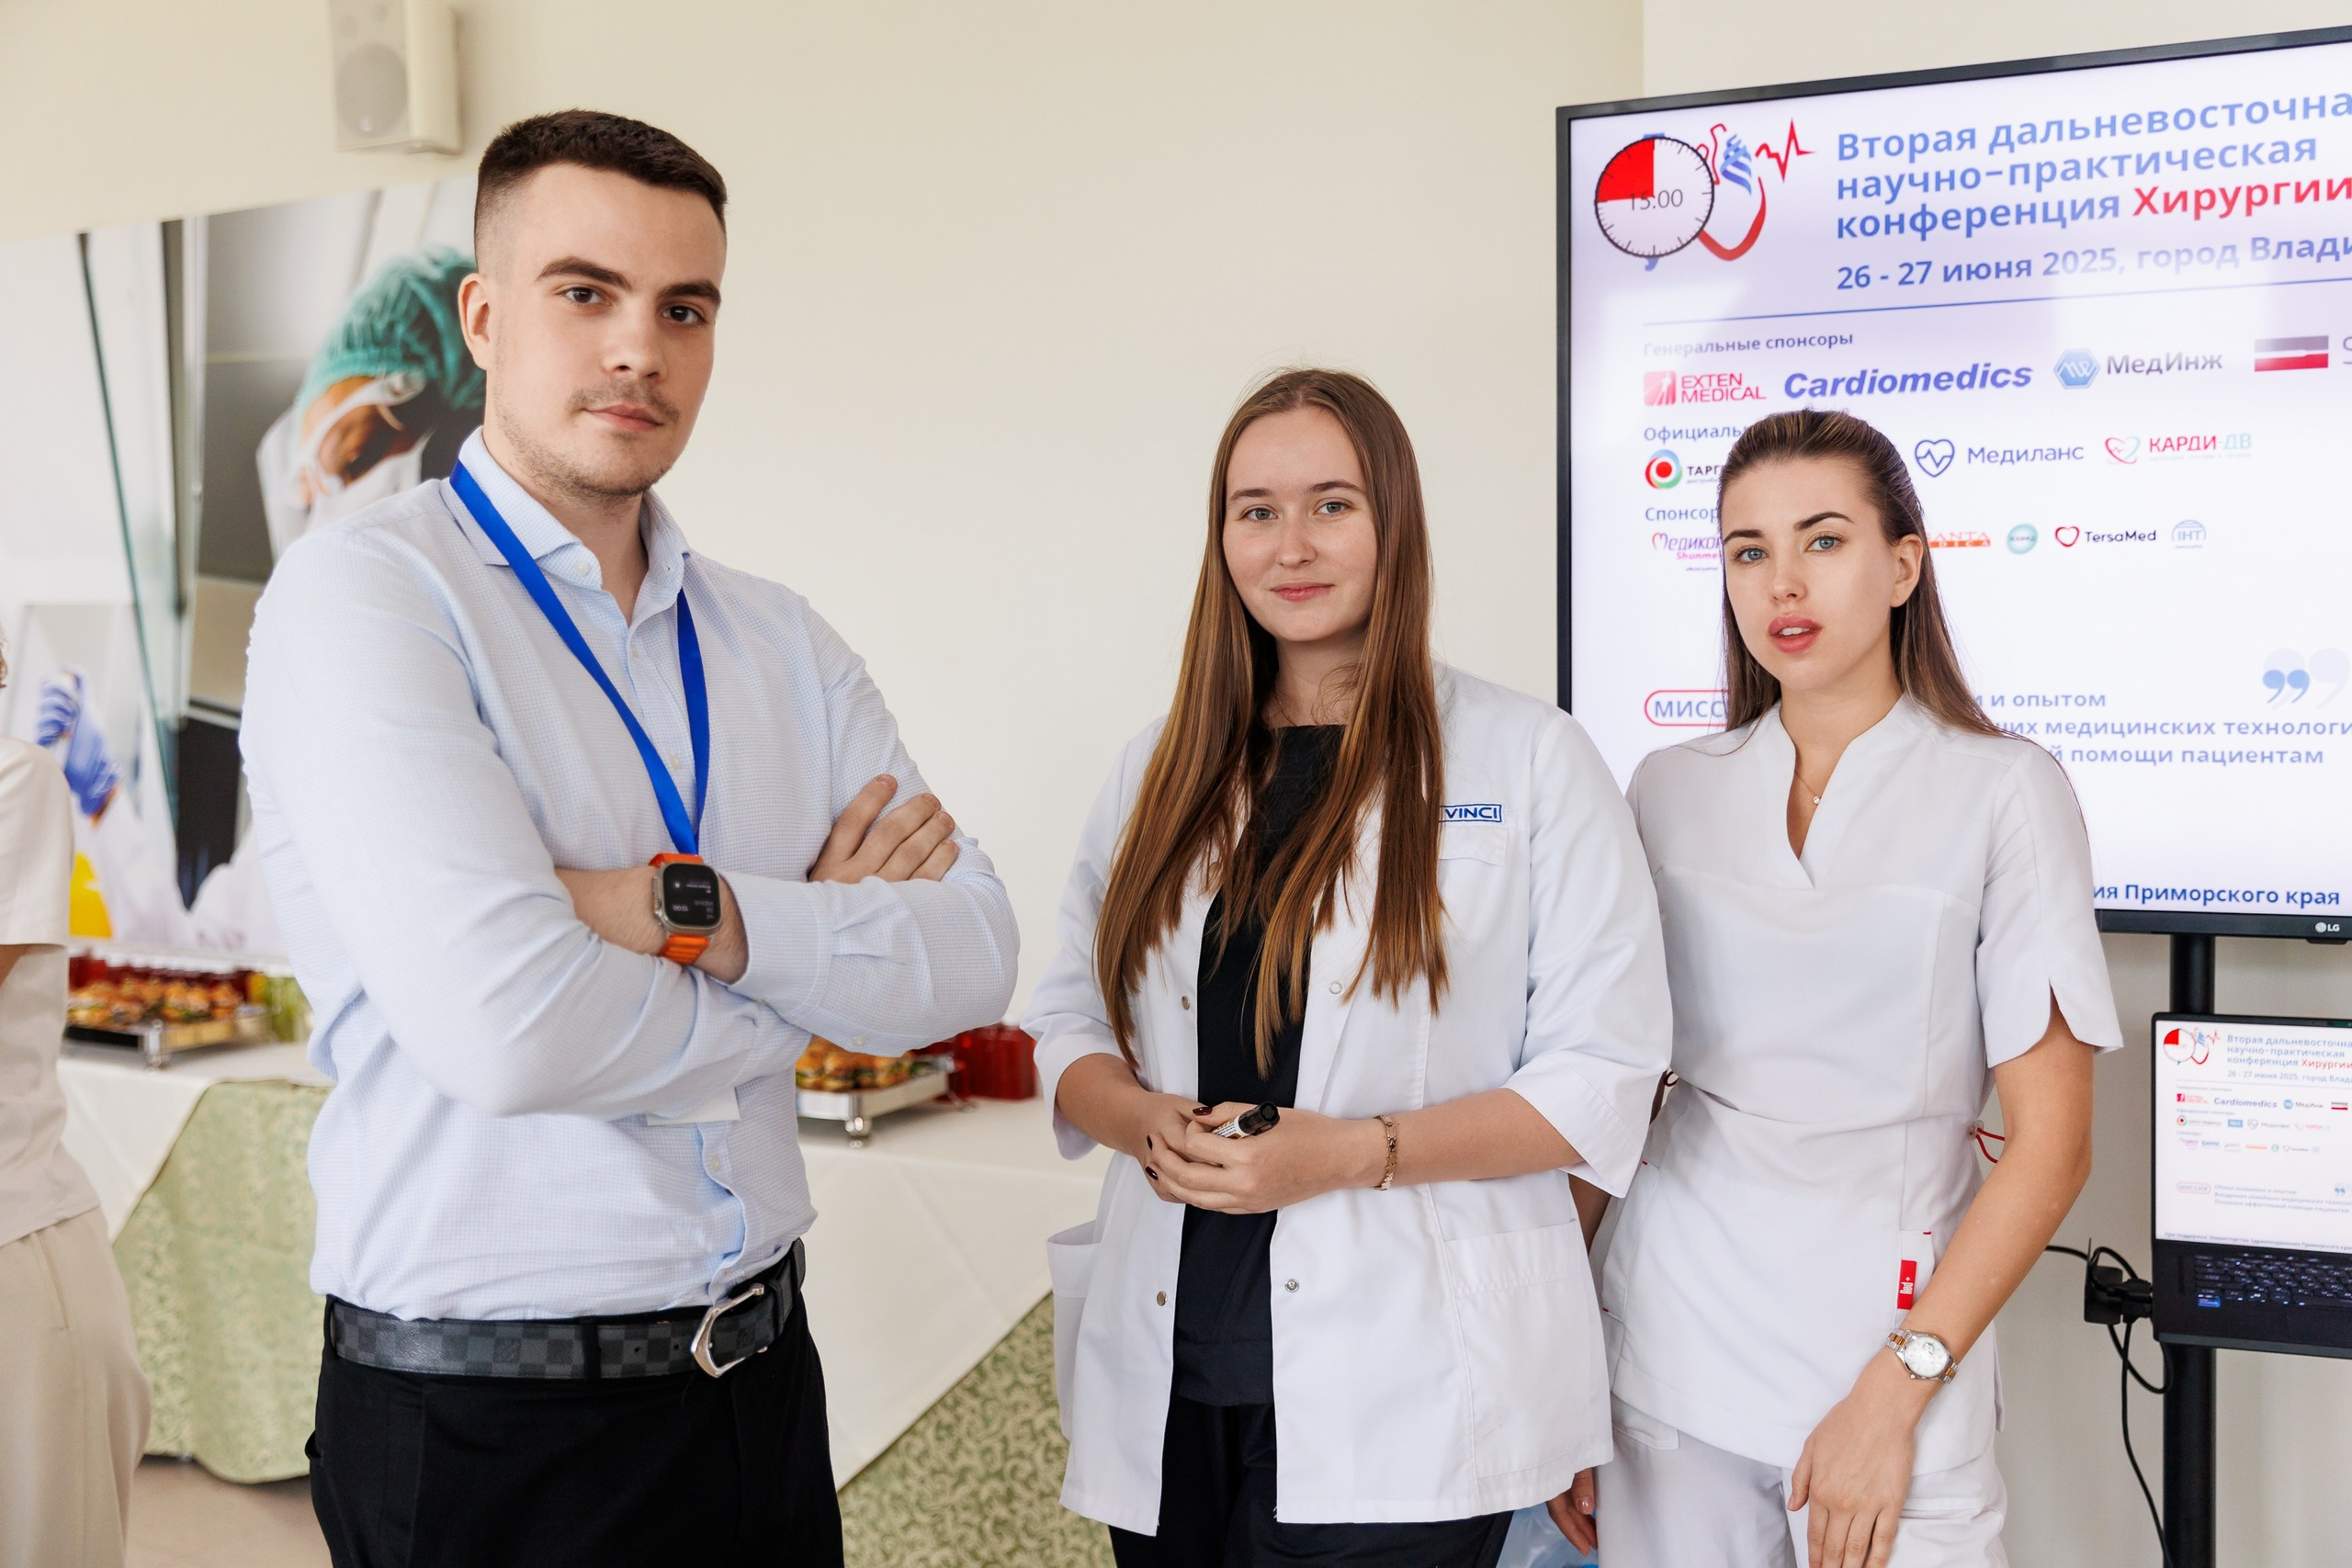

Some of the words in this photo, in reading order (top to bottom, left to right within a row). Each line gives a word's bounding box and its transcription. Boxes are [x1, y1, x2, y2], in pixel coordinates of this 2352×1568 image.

[1838, 127, 1976, 164] Вторая
[1838, 138, 2316, 206] научно-практическая
[1629, 189, 1683, 210] 15:00
[1837, 196, 2120, 242] конференция
[2132, 177, 2352, 220] Хирургии
[1837, 265, 1871, 289] 26
[1898, 261, 1932, 286] 27
[1943, 259, 2031, 282] июня
[2042, 247, 2125, 276] 2025,
[2137, 244, 2239, 276] город
[1644, 340, 1760, 358] Генеральные
[1766, 333, 1853, 349] спонсоры
[2107, 352, 2223, 375] МедИнж
[1681, 373, 1743, 389] EXTEN
[1784, 363, 2034, 399] Cardiomedics
[1681, 387, 1767, 403] MEDICAL
[1644, 426, 1746, 445] Официаль
[1967, 446, 2085, 467] Медиланс
[2085, 530, 2156, 542] TersaMed
[1991, 694, 2005, 706] и
[2013, 694, 2106, 706] опытом
[2046, 722, 2216, 738] медицинских
[2072, 750, 2173, 766] помощи
[2181, 750, 2324, 767] пациентам
[1445, 807, 1498, 818] VINCI
[2125, 885, 2278, 906] Приморского
[2286, 891, 2340, 908] края
[2327, 923, 2340, 931] LG
[2227, 1034, 2264, 1045] Вторая
[2227, 1056, 2299, 1067] конференция
[2213, 1097, 2278, 1109] Cardiomedics
